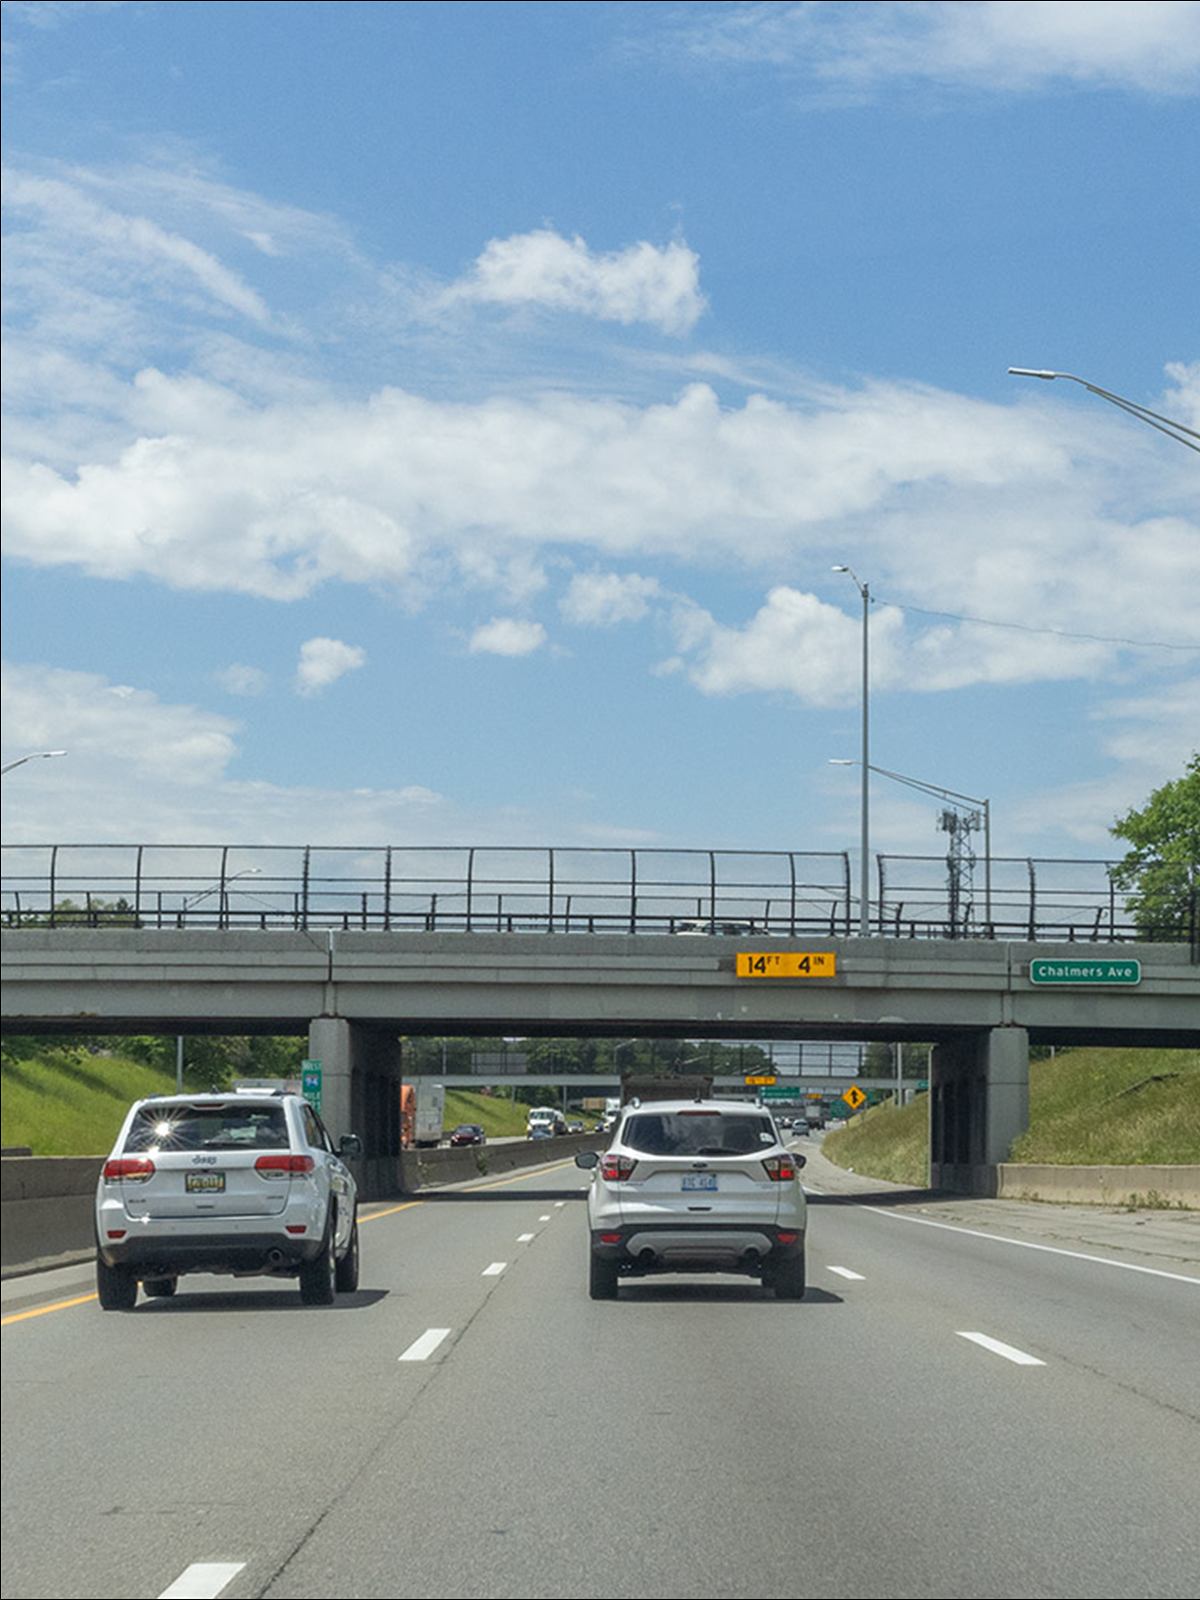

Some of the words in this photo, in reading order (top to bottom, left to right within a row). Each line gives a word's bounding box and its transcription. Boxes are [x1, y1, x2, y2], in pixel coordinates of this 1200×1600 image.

[748, 956, 766, 974] 14
[767, 956, 780, 965] FT
[798, 956, 810, 974] 4
[813, 956, 825, 965] IN
[1038, 966, 1103, 977] Chalmers
[1107, 966, 1133, 977] Ave
